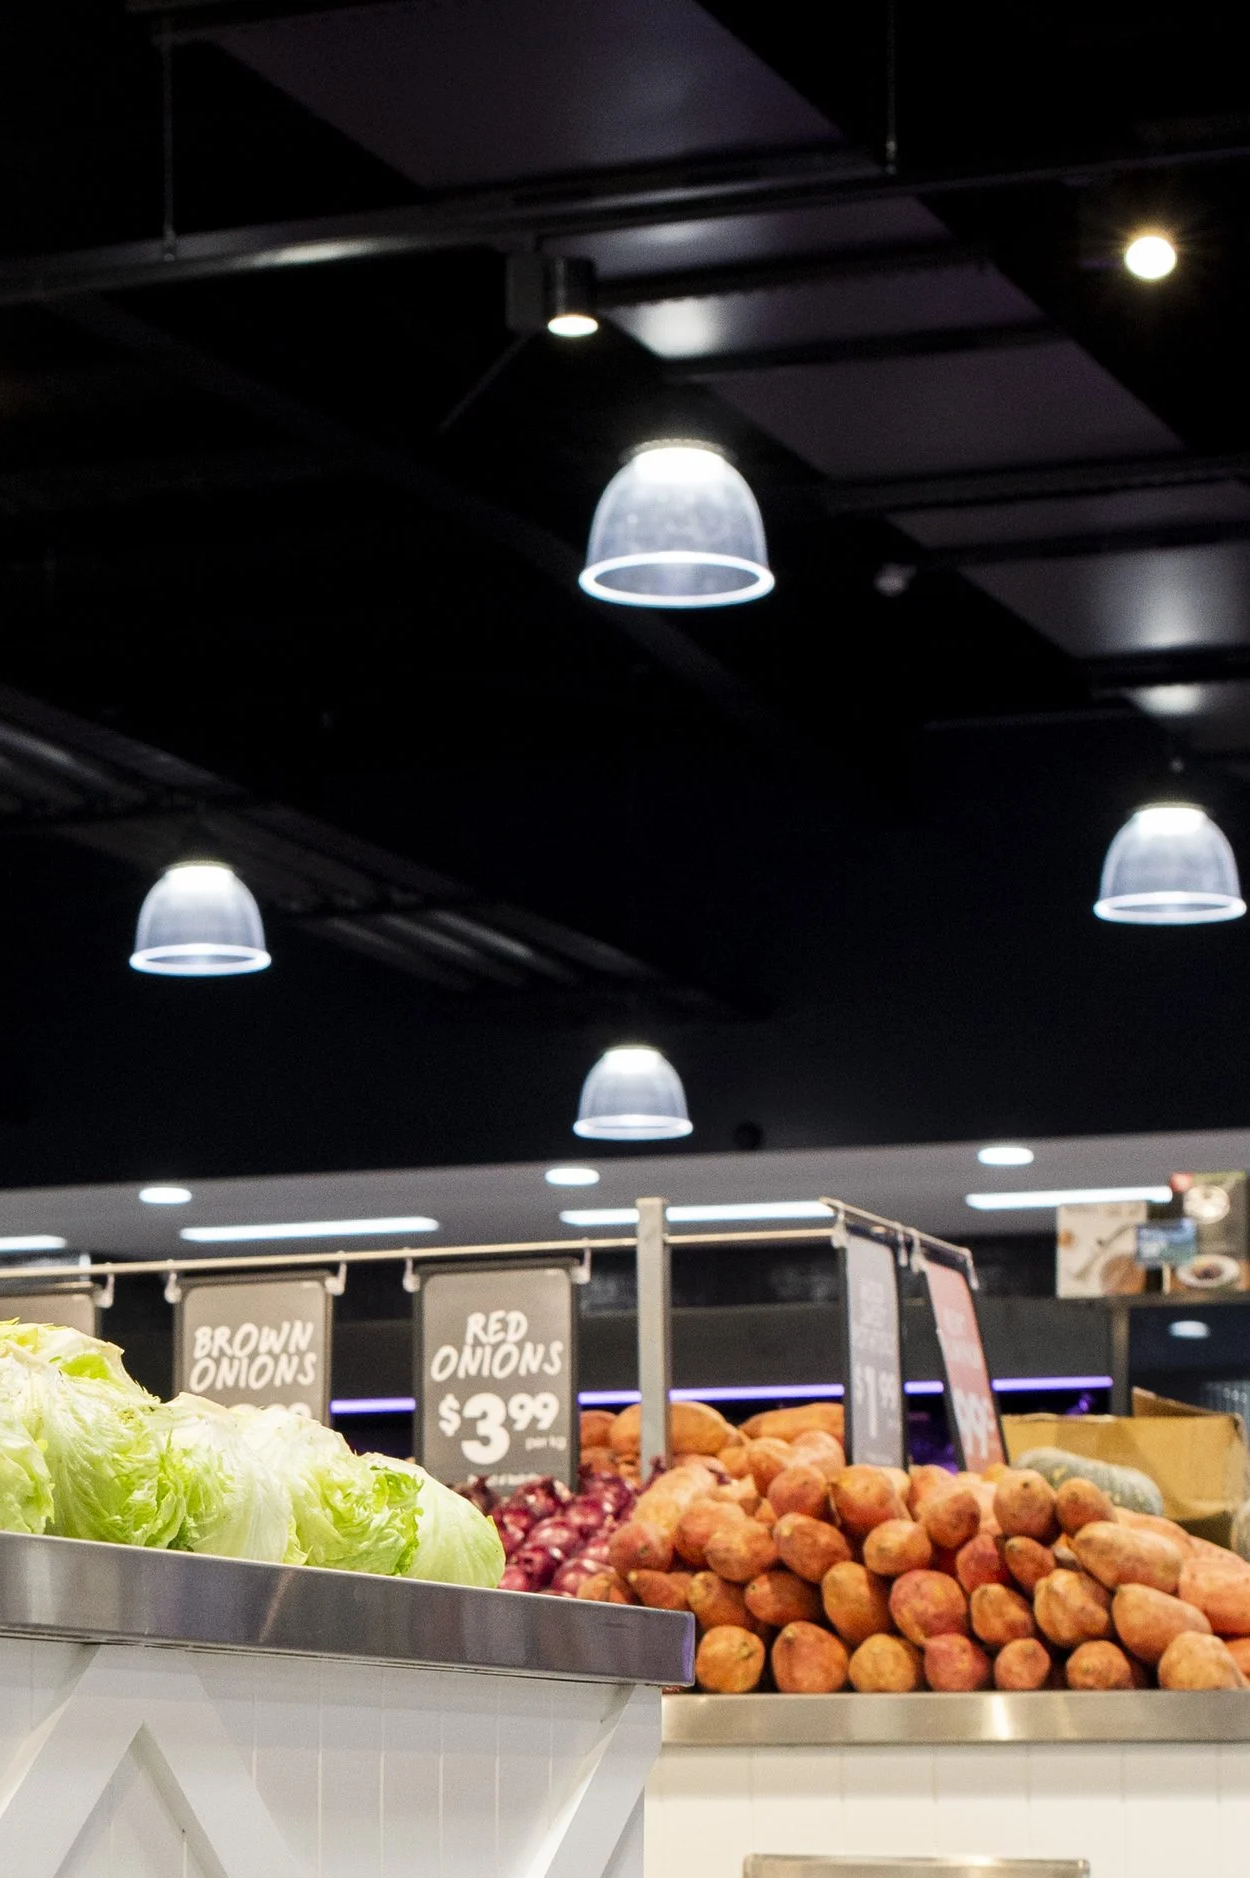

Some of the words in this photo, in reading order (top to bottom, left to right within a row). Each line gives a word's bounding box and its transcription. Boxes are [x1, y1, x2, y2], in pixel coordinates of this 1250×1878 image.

[192, 1319, 315, 1360] BROWN
[465, 1310, 529, 1345] RED
[188, 1352, 318, 1394] ONIONS
[430, 1340, 565, 1382] ONIONS
